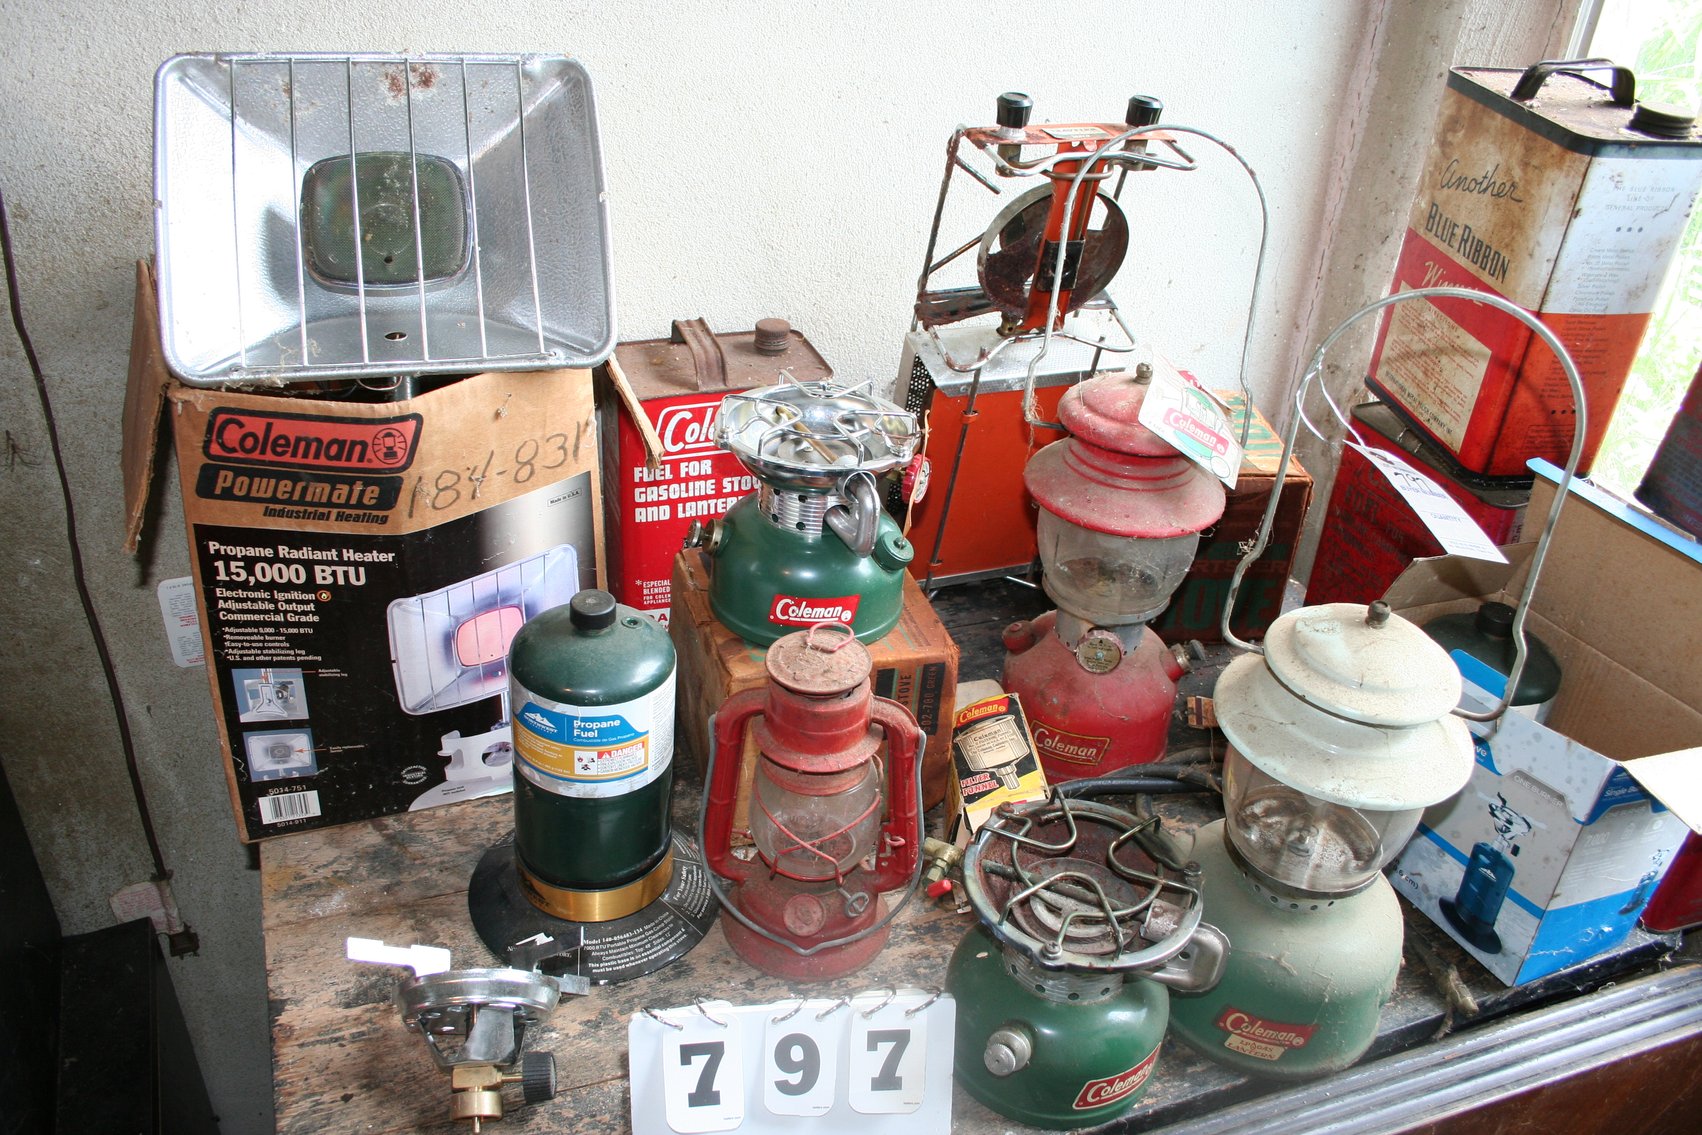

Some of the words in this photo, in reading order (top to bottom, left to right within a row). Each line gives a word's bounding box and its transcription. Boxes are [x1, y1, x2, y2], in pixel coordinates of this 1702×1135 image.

[1440, 158, 1523, 203] Another
[1425, 202, 1459, 249] BLUE
[1456, 223, 1511, 285] RIBBON
[664, 408, 716, 452] Cole
[1169, 411, 1217, 444] Coleman
[216, 417, 369, 463] Coleman
[634, 464, 673, 482] FUEL
[680, 459, 712, 477] FOR
[214, 469, 381, 506] Powermate
[634, 479, 716, 503] GASOLINE
[722, 475, 761, 493] STOV
[263, 505, 330, 521] Industrial
[334, 511, 389, 525] Heating
[635, 506, 670, 522] AND
[677, 496, 741, 519] LANTER
[208, 541, 274, 558] Propane
[278, 545, 339, 560] Radiant
[343, 549, 396, 562] Heater
[214, 560, 307, 586] 15,000
[314, 565, 366, 586] BTU
[643, 579, 671, 588] ESPECIAL
[215, 588, 271, 599] Electronic
[274, 590, 315, 601] Ignition
[643, 586, 670, 595] BLENDED
[217, 600, 275, 611] Adjustable
[278, 602, 315, 612] Output
[219, 611, 284, 622] Commercial
[287, 612, 320, 623] Grade
[776, 598, 842, 620] Coleman
[898, 674, 912, 705] STOVE
[573, 719, 621, 730] Propane
[960, 703, 999, 723] Coleman
[573, 729, 598, 738] Fuel
[1033, 728, 1098, 758] Coleman
[611, 742, 643, 758] DANGER
[960, 772, 991, 788] FILTER
[962, 780, 999, 797] FUNNEL
[1226, 1012, 1296, 1041] Coleman
[679, 1040, 725, 1108] 7
[773, 1032, 821, 1096] 9
[866, 1029, 911, 1092] 7
[1087, 1063, 1149, 1103] Coleman
